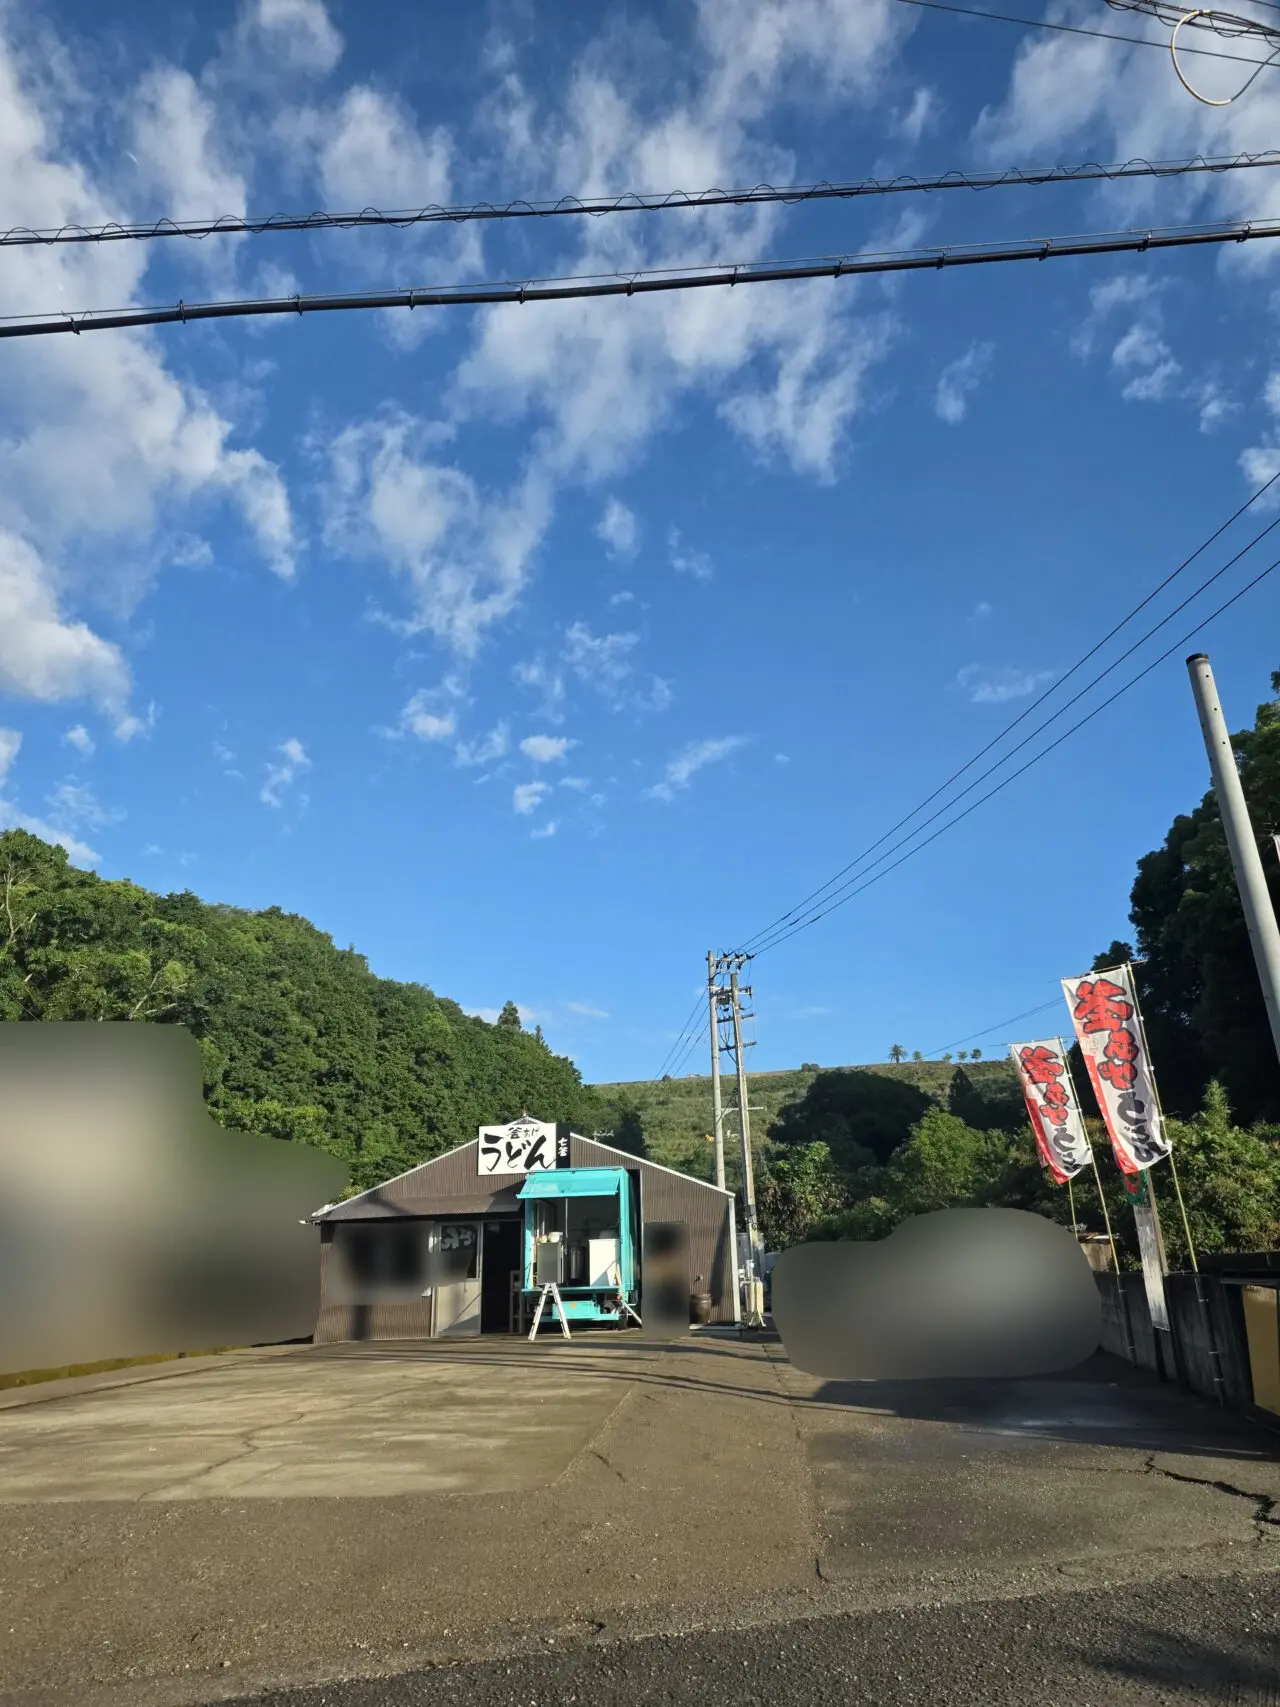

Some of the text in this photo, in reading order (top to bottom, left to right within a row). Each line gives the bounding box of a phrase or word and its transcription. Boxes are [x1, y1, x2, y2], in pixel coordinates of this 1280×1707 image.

[506, 1126, 540, 1140] 釜あげ
[481, 1133, 556, 1172] うどん
